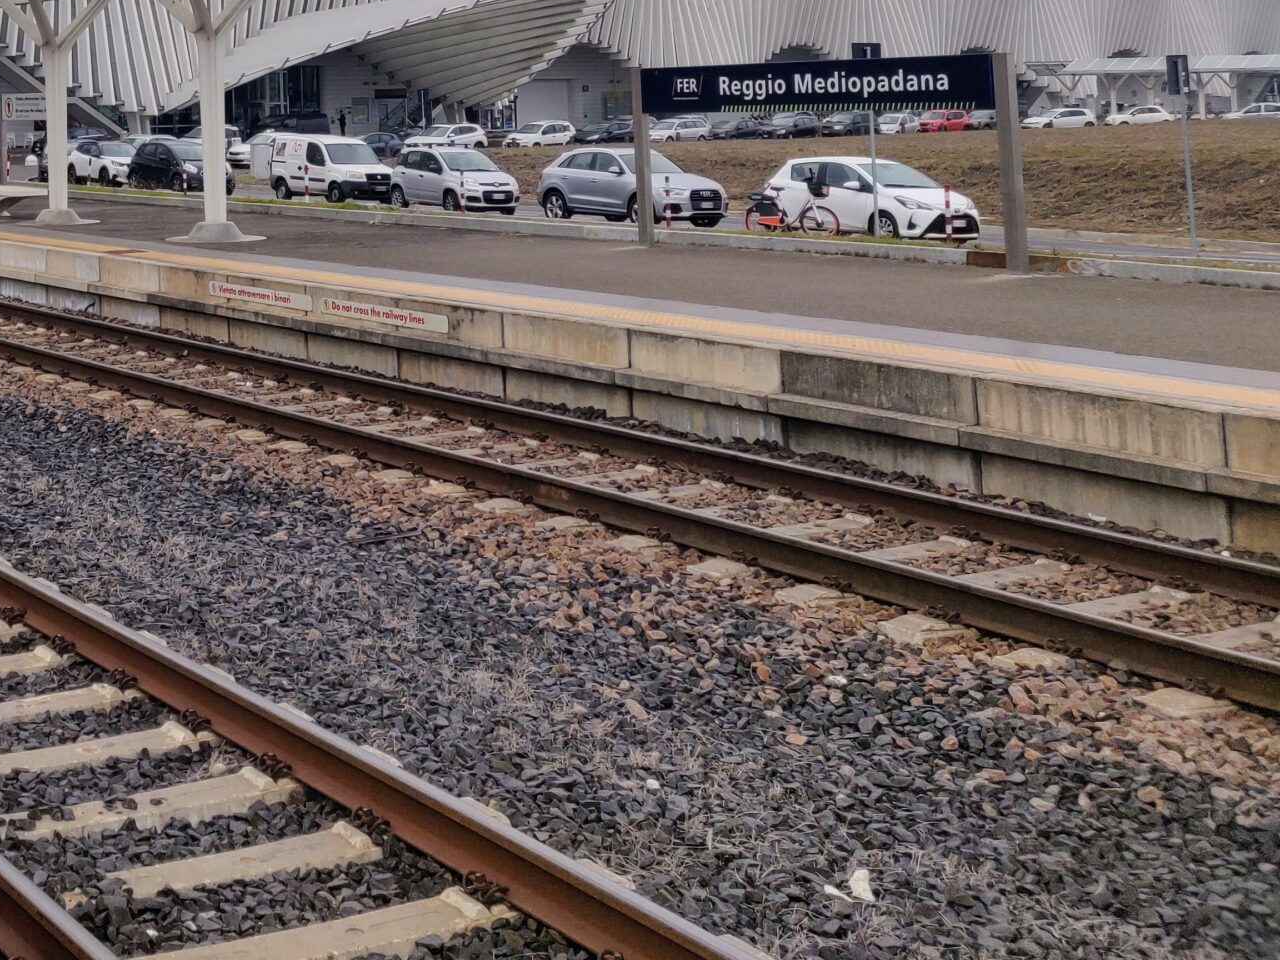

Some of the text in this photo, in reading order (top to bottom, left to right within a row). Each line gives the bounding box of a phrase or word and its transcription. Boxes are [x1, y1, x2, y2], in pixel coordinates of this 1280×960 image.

[677, 69, 949, 100] FER Reggio Mediopadana
[219, 284, 237, 296] Vietato
[238, 289, 271, 302] attraversare
[274, 291, 291, 304] binari
[331, 301, 425, 325] Do not cross the railway lines
